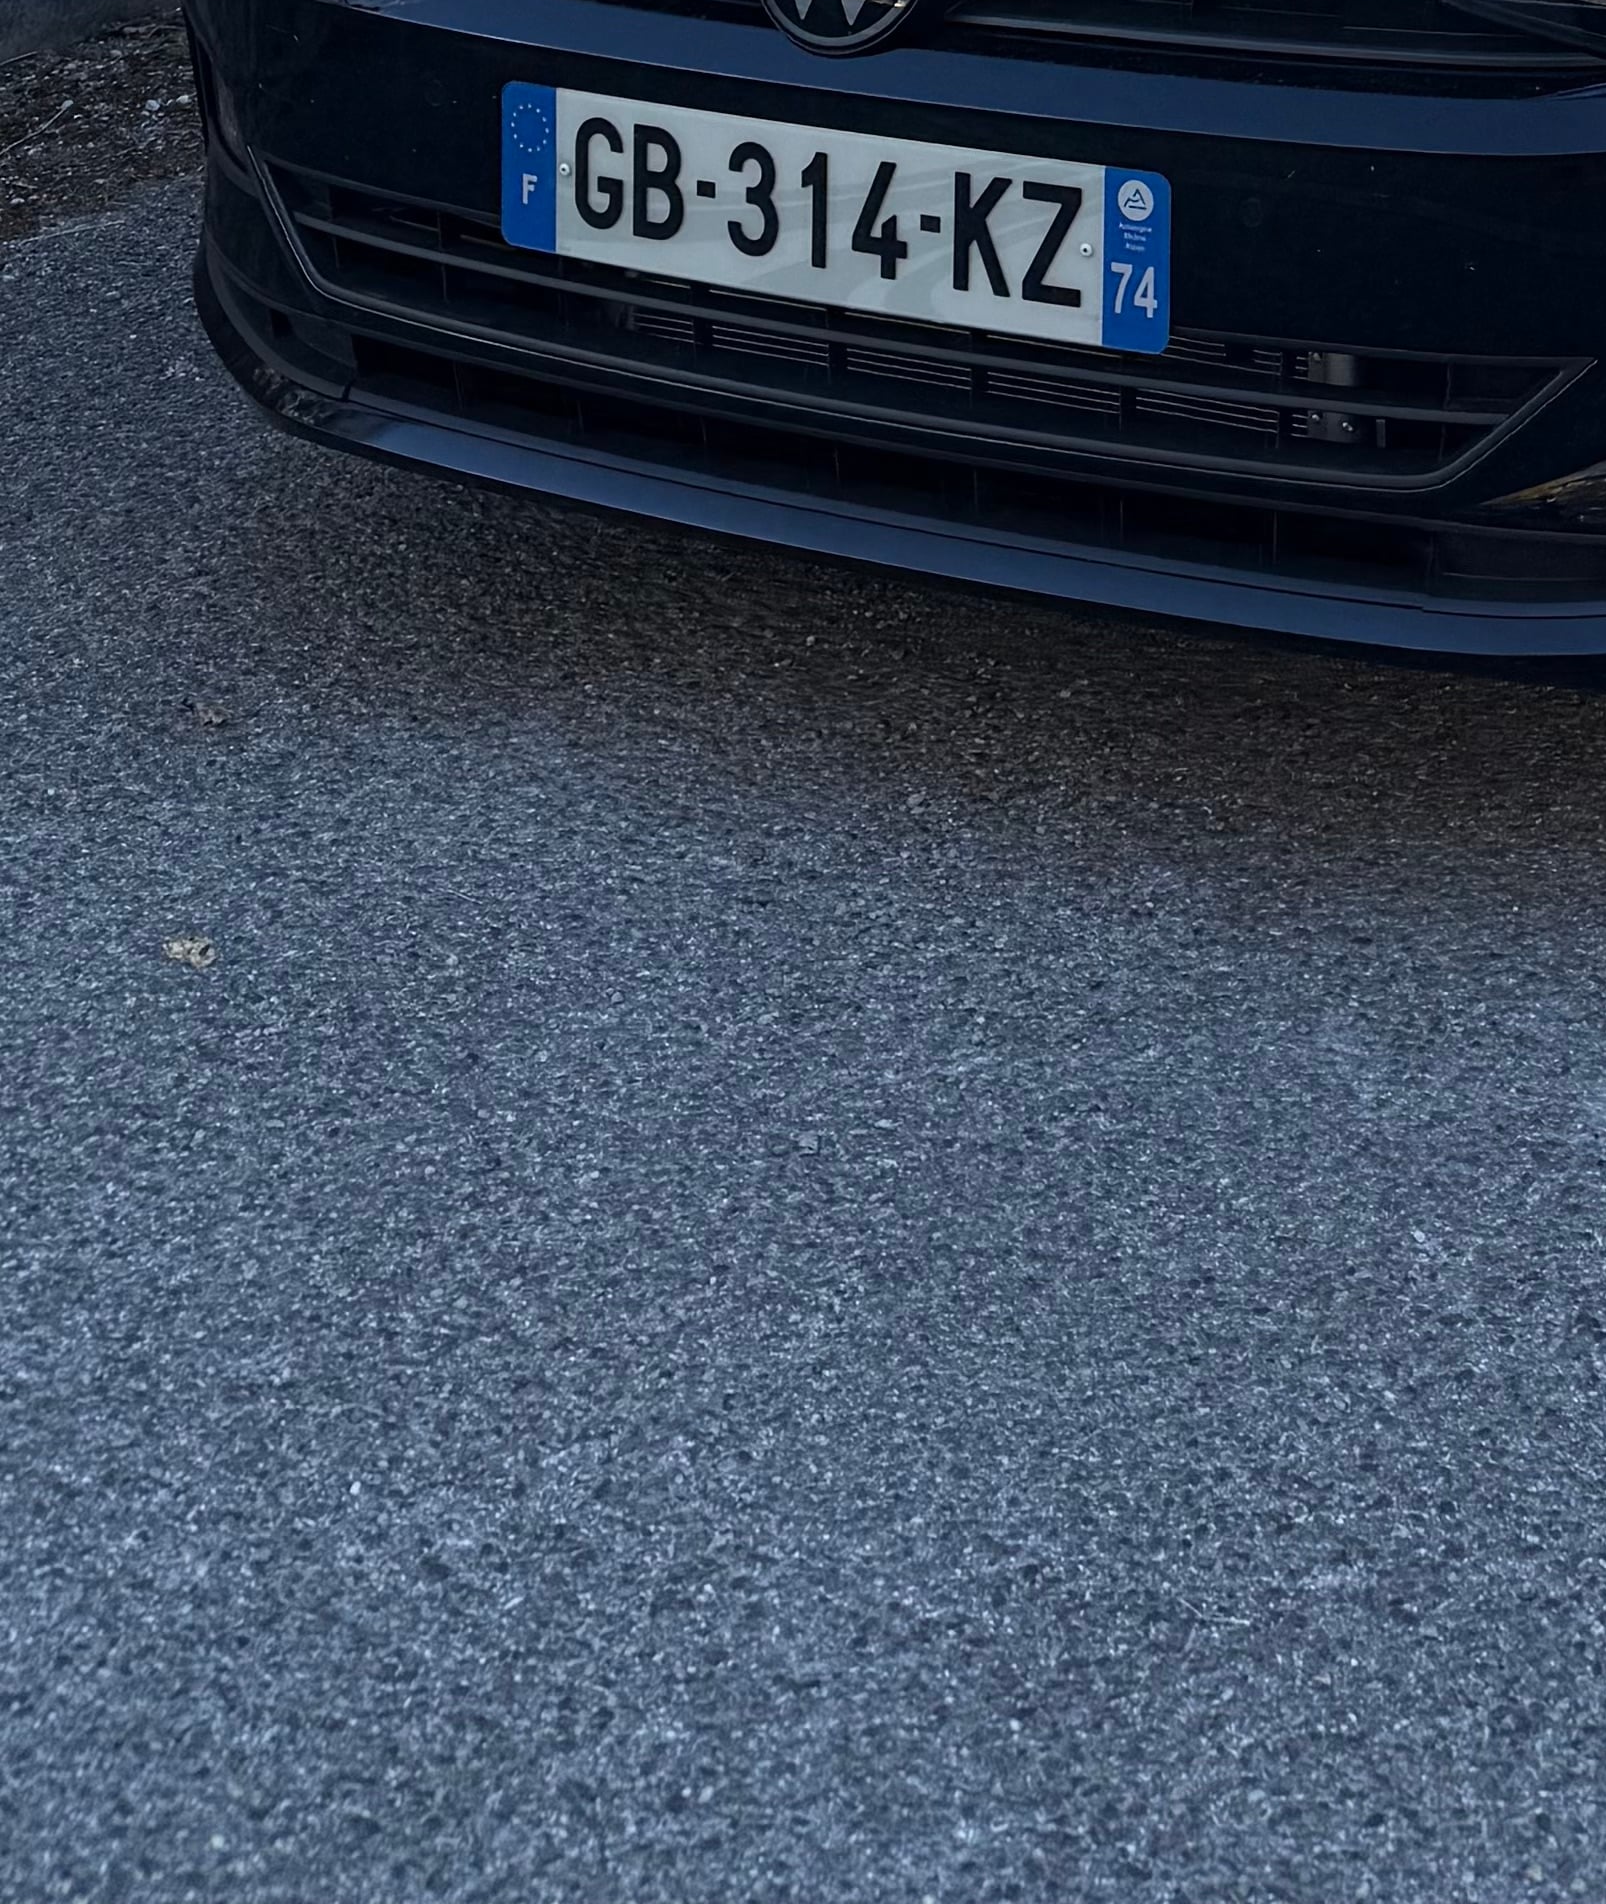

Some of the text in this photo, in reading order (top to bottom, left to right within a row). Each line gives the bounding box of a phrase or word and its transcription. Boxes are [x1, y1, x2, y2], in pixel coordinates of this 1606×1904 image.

[522, 172, 538, 205] F
[573, 116, 1083, 308] GB-314-KZ
[1110, 261, 1158, 319] 74
